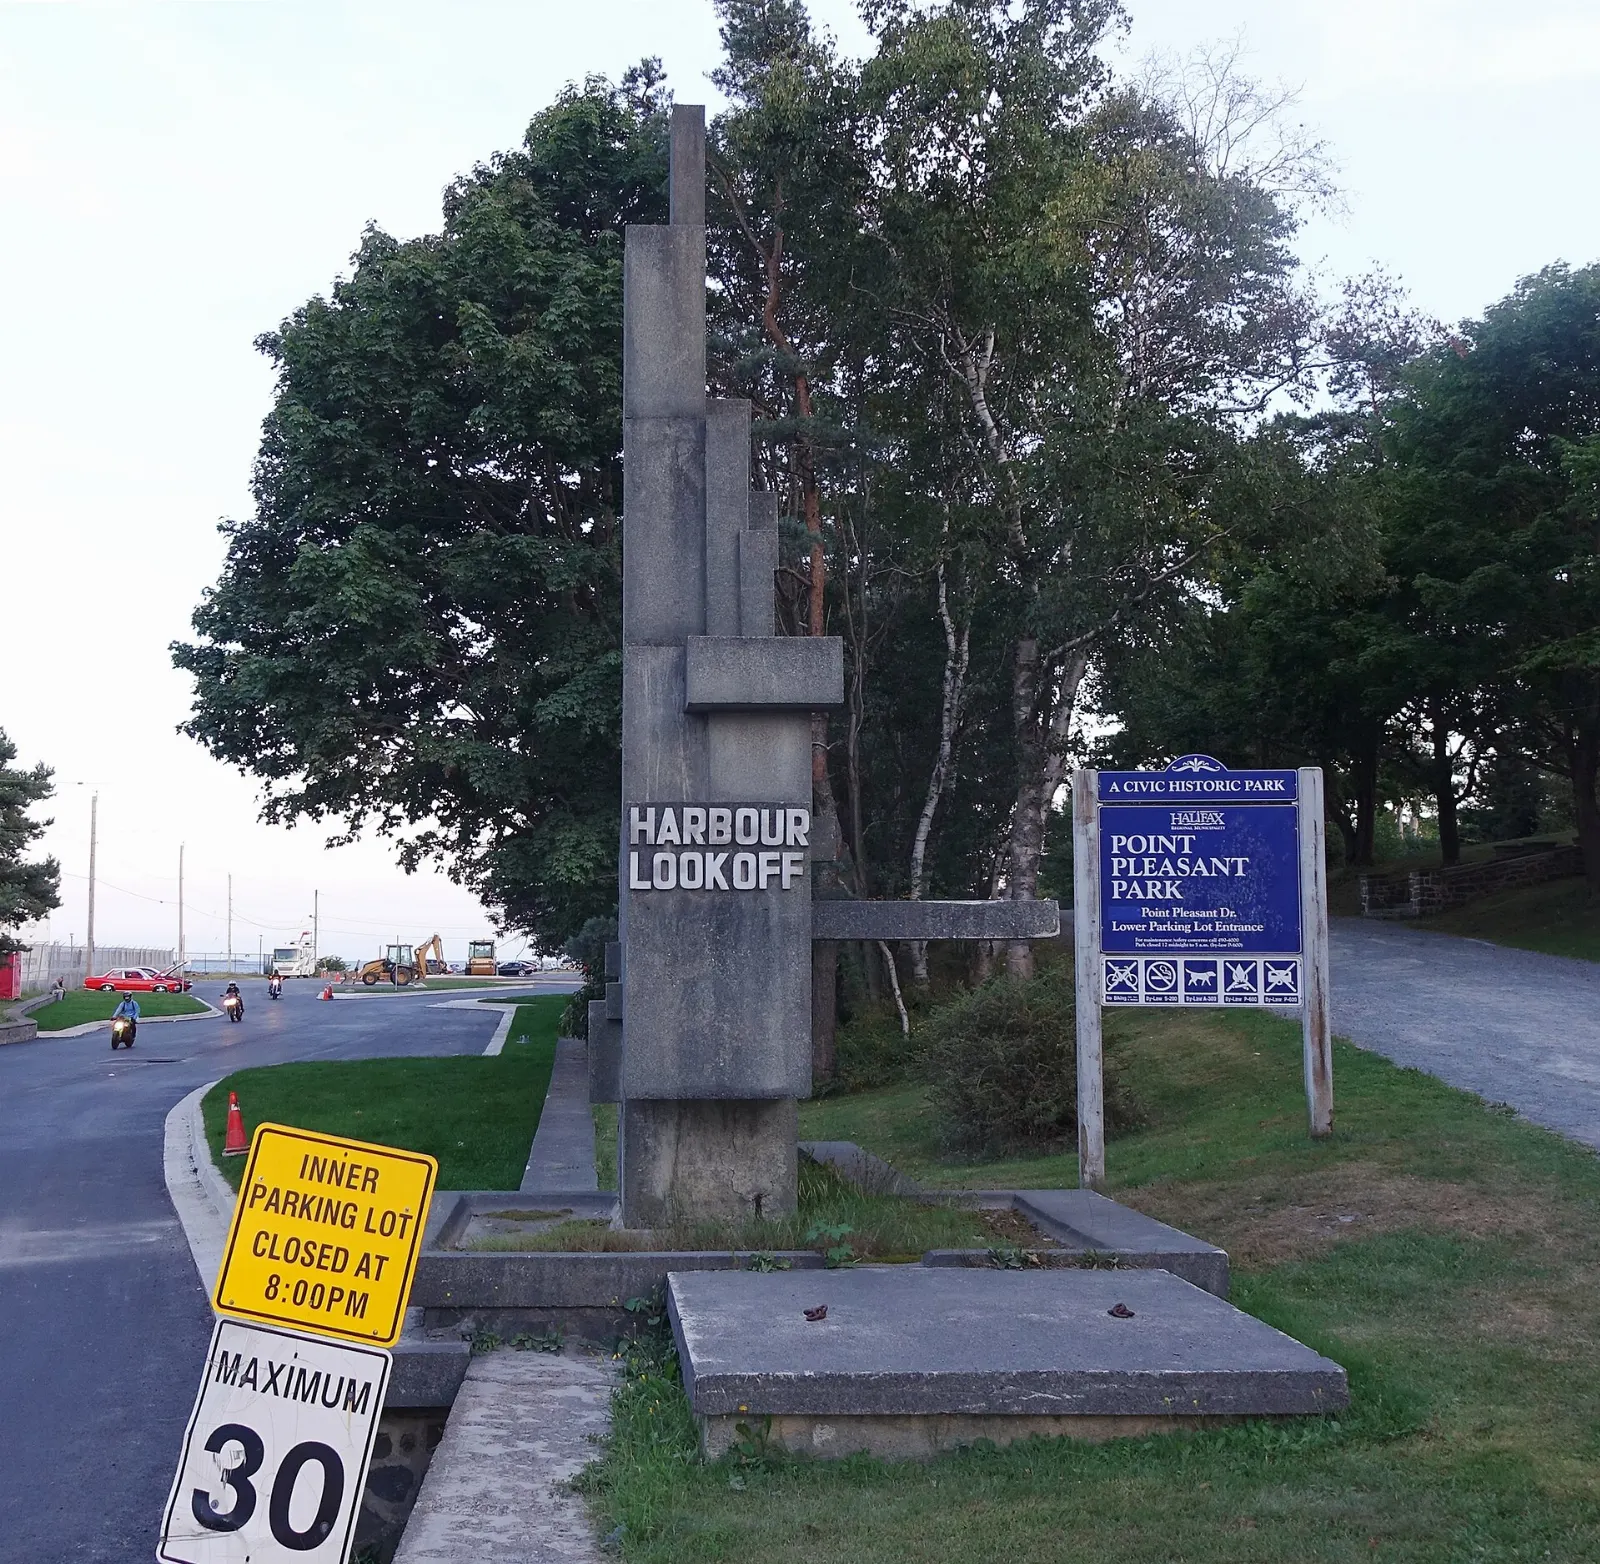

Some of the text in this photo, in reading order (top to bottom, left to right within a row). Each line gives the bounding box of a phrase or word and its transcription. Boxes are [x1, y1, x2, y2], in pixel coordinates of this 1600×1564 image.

[1109, 780, 1285, 792] A CIVIC HISTORIC PARK
[630, 807, 810, 846] HARBOUR
[1169, 811, 1226, 826] HALIFAX
[1111, 835, 1196, 855] POINT
[629, 851, 804, 890] LOOKOFF
[1111, 857, 1249, 877] PLEASANT
[1111, 880, 1184, 899] PARK
[1112, 920, 1264, 933] Lower Parking Lot Entrance
[1141, 907, 1237, 918] Point Pleasant Dr.
[299, 1154, 380, 1194] INNER
[248, 1183, 413, 1240] PARKING LOT
[252, 1230, 389, 1282] CLOSED AT
[264, 1273, 369, 1319] 8:00PM
[215, 1350, 372, 1415] MAXIMUM
[191, 1423, 345, 1551] 30
